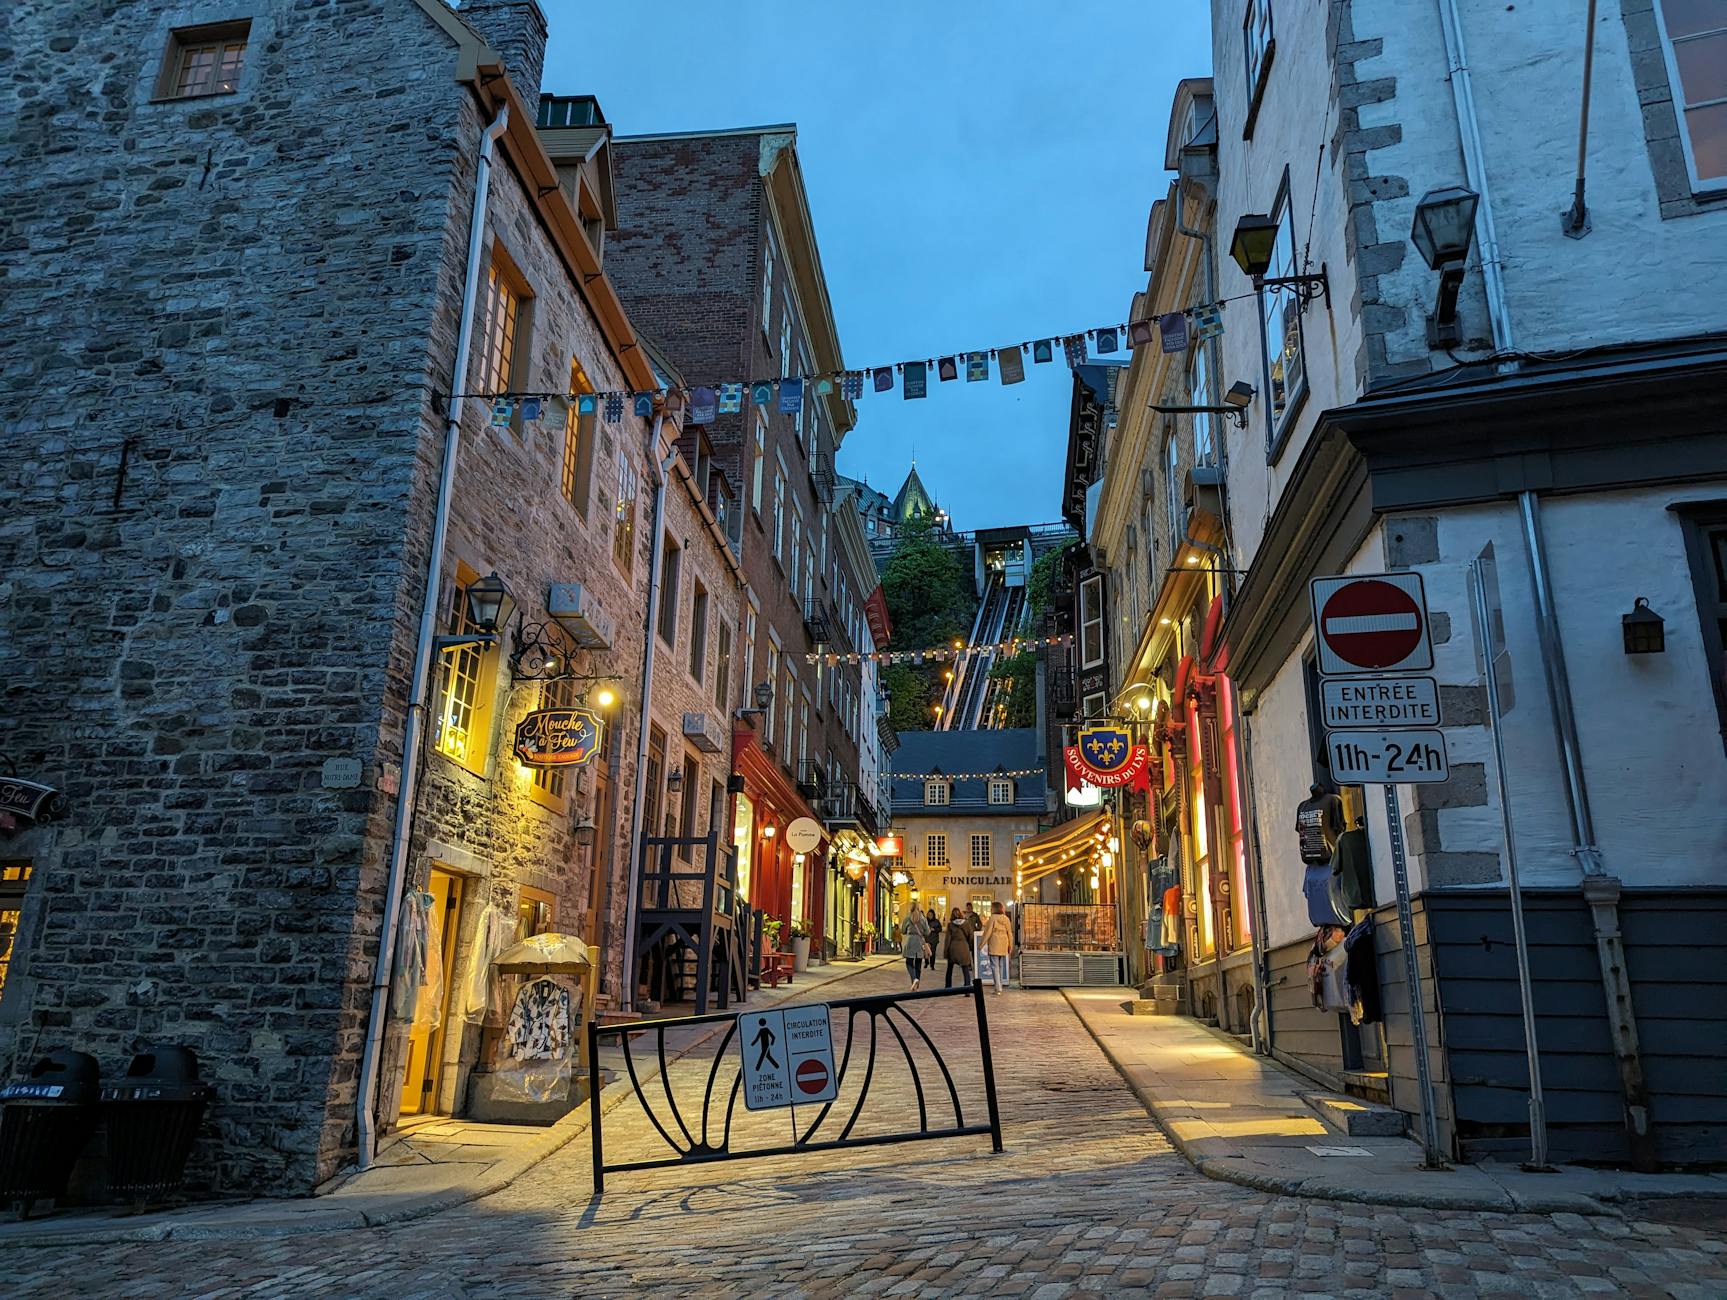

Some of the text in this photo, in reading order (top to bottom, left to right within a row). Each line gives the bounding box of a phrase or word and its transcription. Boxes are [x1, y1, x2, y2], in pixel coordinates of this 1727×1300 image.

[1341, 682, 1417, 701] ENTRÉE
[1331, 703, 1432, 720] INTERDITE
[525, 711, 584, 736] Mouche
[549, 731, 578, 750] Feu
[1067, 748, 1146, 785] SOUVENIRS DU LYS
[786, 1018, 827, 1030] CIRCULATION
[792, 1029, 823, 1040] INTERDITE
[759, 1073, 776, 1082] ZONE
